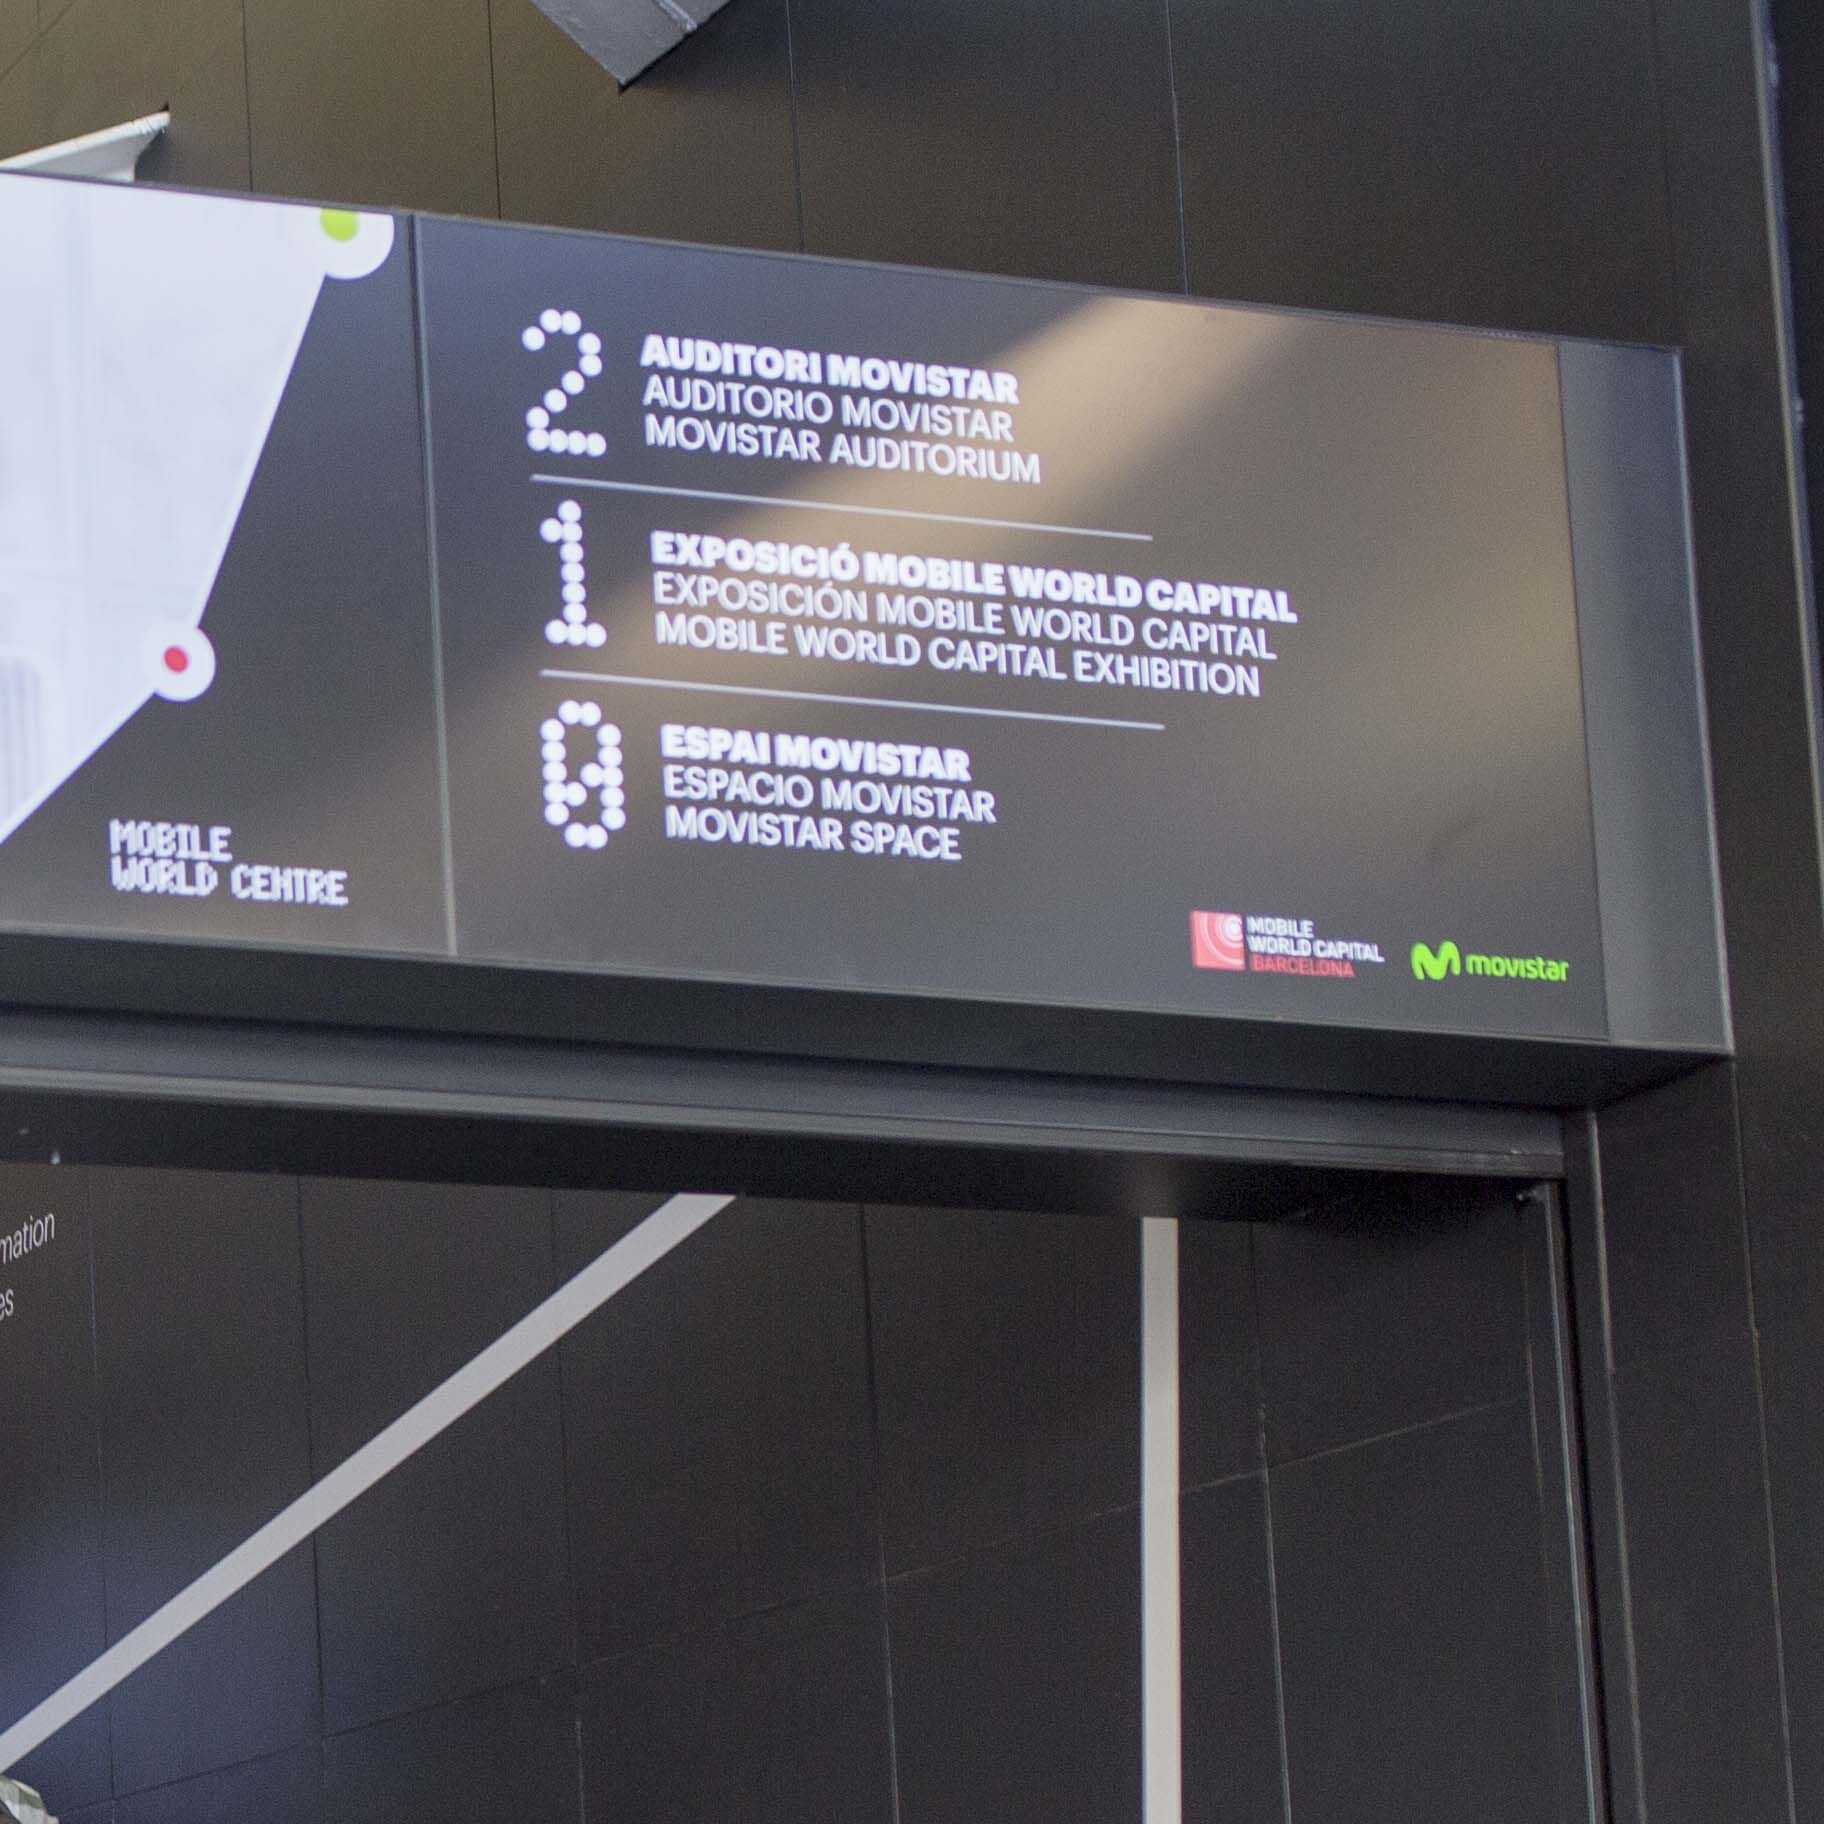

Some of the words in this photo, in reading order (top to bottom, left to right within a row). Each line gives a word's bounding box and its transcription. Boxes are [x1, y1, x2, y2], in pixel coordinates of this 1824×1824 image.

[522, 309, 605, 457] 2
[641, 335, 821, 383] AUDITORI
[827, 355, 1023, 407] MOVISTAR
[644, 377, 833, 423] AUDITORIO
[842, 395, 1018, 446] MOVISTAR
[646, 416, 821, 461] MOVISTAR
[830, 434, 1040, 484] AUDITORIUM
[541, 500, 606, 647] 1
[652, 531, 860, 584] EXPOSICIÓ
[863, 552, 1005, 595] MOBILE
[1008, 566, 1142, 607] WORLD
[1146, 579, 1297, 622] CAPITAL
[655, 572, 867, 621] EXPOSICIÓN
[876, 592, 1004, 634] MOBILE
[1011, 606, 1134, 645] WORLD
[1142, 618, 1276, 659] CAPITAL
[656, 613, 787, 654] MOBILE
[794, 624, 920, 665] WORLD
[928, 637, 1067, 679] CAPITAL
[1074, 650, 1259, 696] EXHIBITION
[661, 724, 770, 764] ESPAI
[775, 734, 971, 781] MOVISTAR
[664, 765, 813, 807] ESPACIO
[822, 778, 996, 822] MOVISTAR
[109, 819, 232, 862] MOBILE
[666, 806, 844, 850] MOVISTAR
[851, 821, 961, 860] SPACE
[111, 857, 218, 897] WORLD
[231, 865, 348, 906] CENTRE
[1247, 916, 1314, 938] MOBILE
[1248, 936, 1311, 956] WORLD
[1314, 939, 1385, 963] CAPITAL
[1253, 956, 1355, 977] BARCELONA
[1466, 954, 1569, 982] movistar
